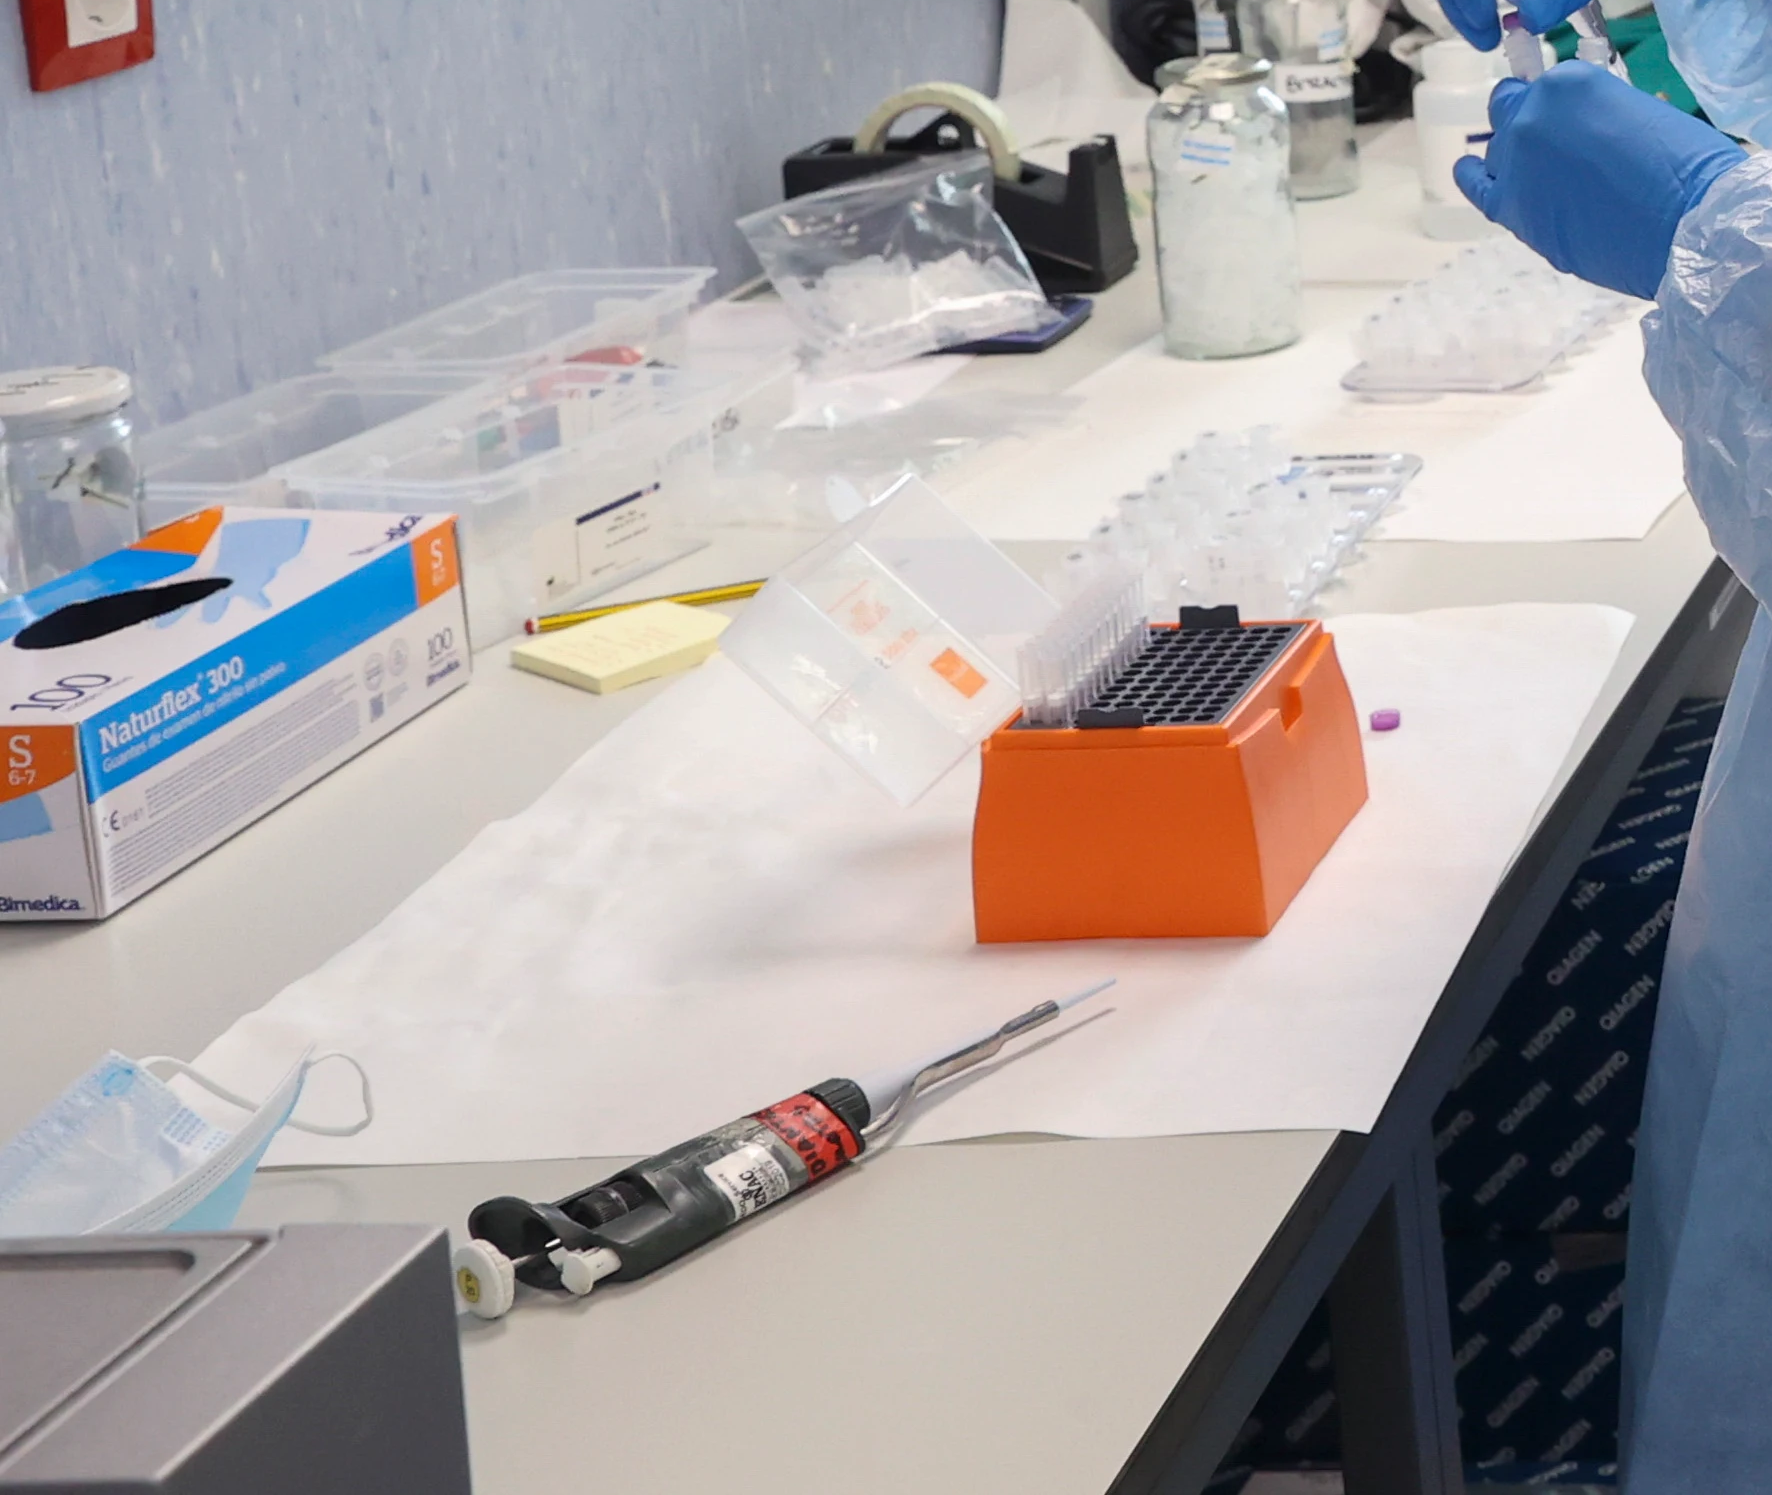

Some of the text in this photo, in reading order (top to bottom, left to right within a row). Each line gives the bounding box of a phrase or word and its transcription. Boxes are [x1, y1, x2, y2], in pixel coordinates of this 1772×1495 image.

[430, 538, 444, 569] S
[427, 627, 453, 662] 100
[10, 673, 112, 711] 100
[98, 655, 245, 754] Naturflex 300
[8, 734, 33, 769] S
[8, 769, 36, 786] 6-7
[1547, 929, 1603, 986] QIAGEN
[1600, 973, 1655, 1031] QIAGEN
[1520, 1005, 1577, 1062] QIAGEN
[1573, 1050, 1630, 1106] QIAGEN
[1497, 1079, 1552, 1135] QIAGEN
[1550, 1122, 1606, 1178] QIAGEN
[737, 1168, 766, 1208] ENAC
[1457, 1260, 1512, 1315] QIAGEN
[1509, 1303, 1564, 1359] QIAGEN
[1486, 1373, 1540, 1428] QIAGEN
[1561, 1347, 1616, 1401] QIAGEN
